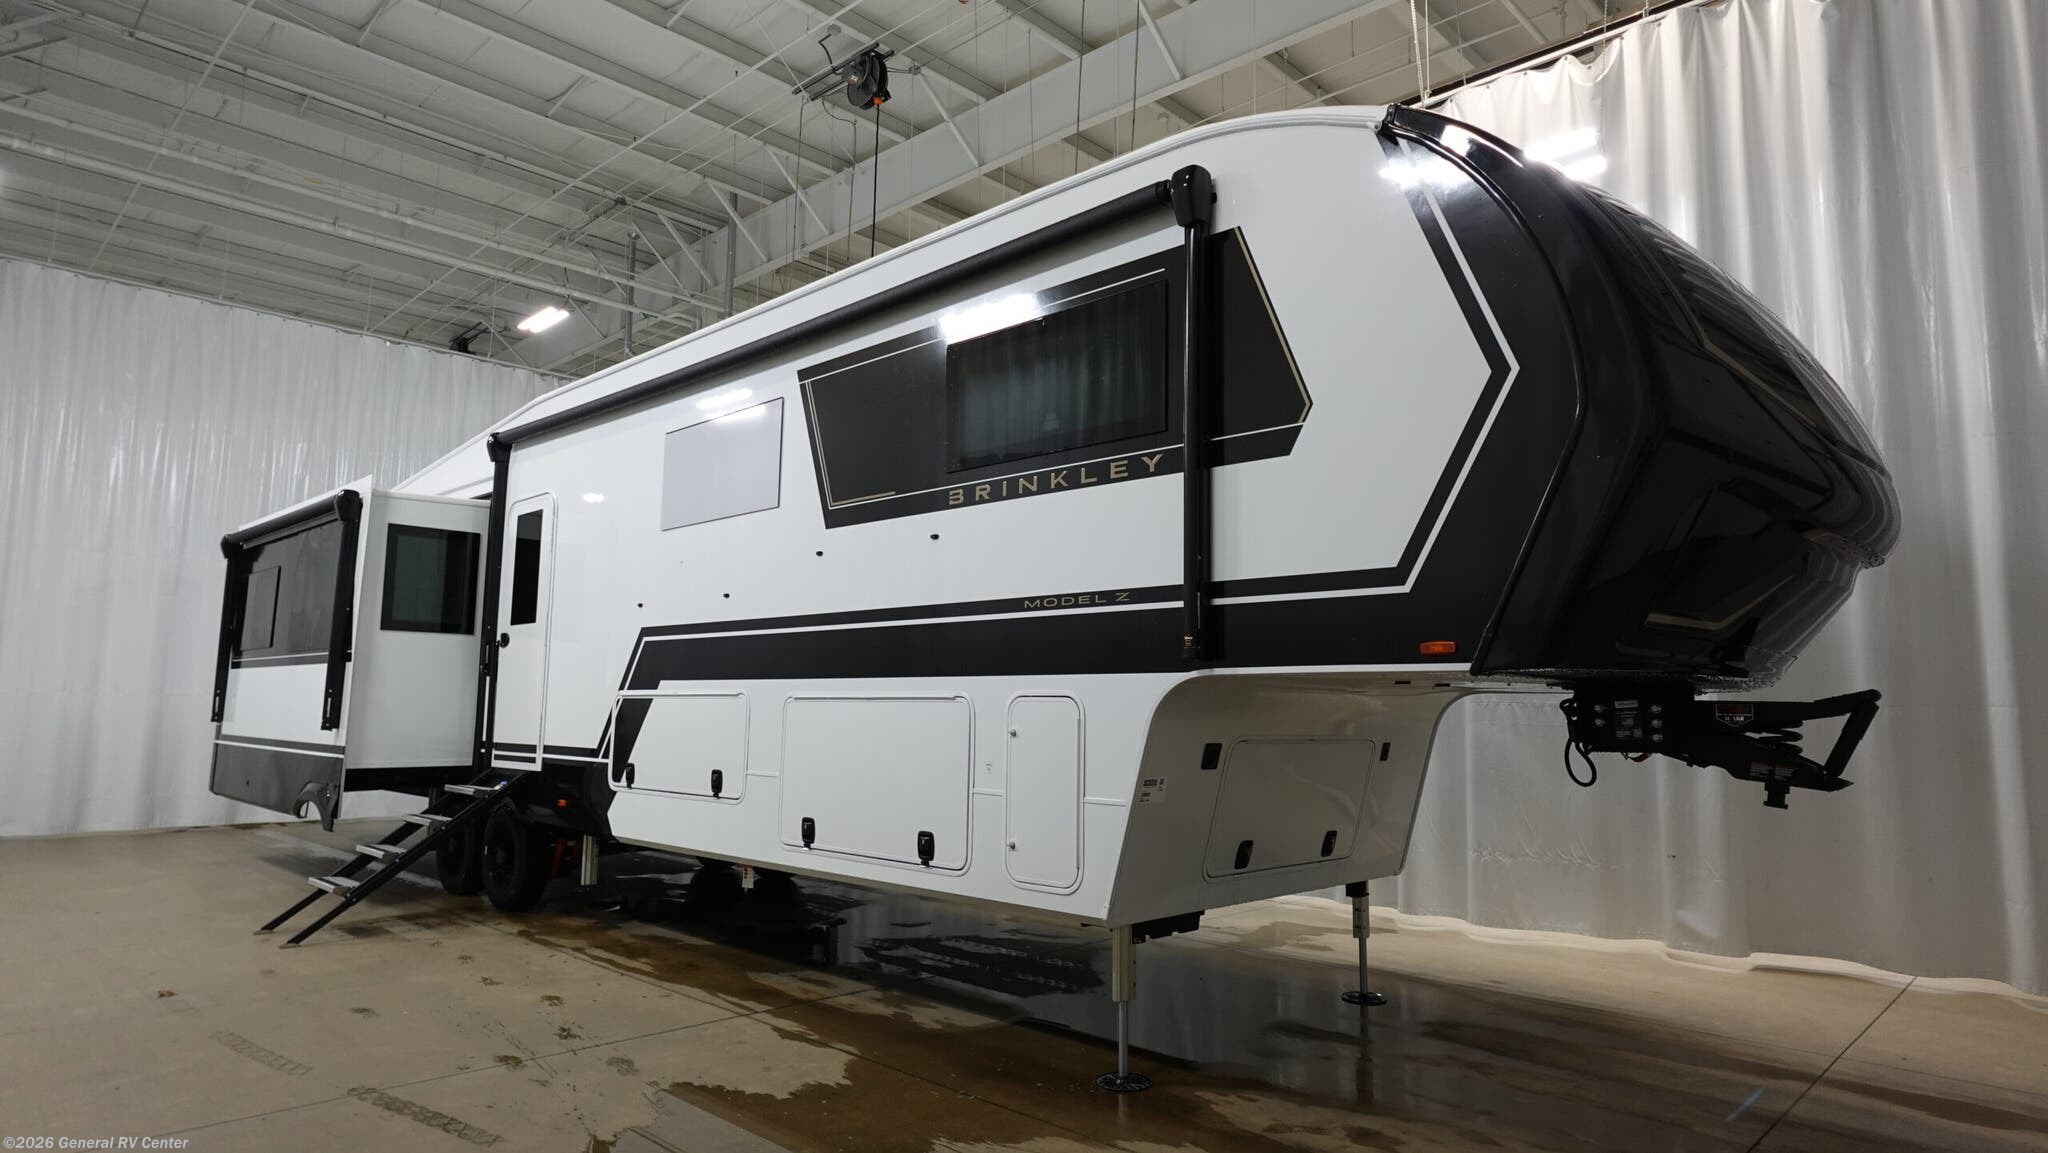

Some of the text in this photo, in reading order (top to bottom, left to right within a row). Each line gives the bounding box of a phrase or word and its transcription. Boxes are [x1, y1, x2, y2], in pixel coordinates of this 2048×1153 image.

[948, 453, 1164, 505] BRINKLEY
[1024, 591, 1130, 609] MODEL Z
